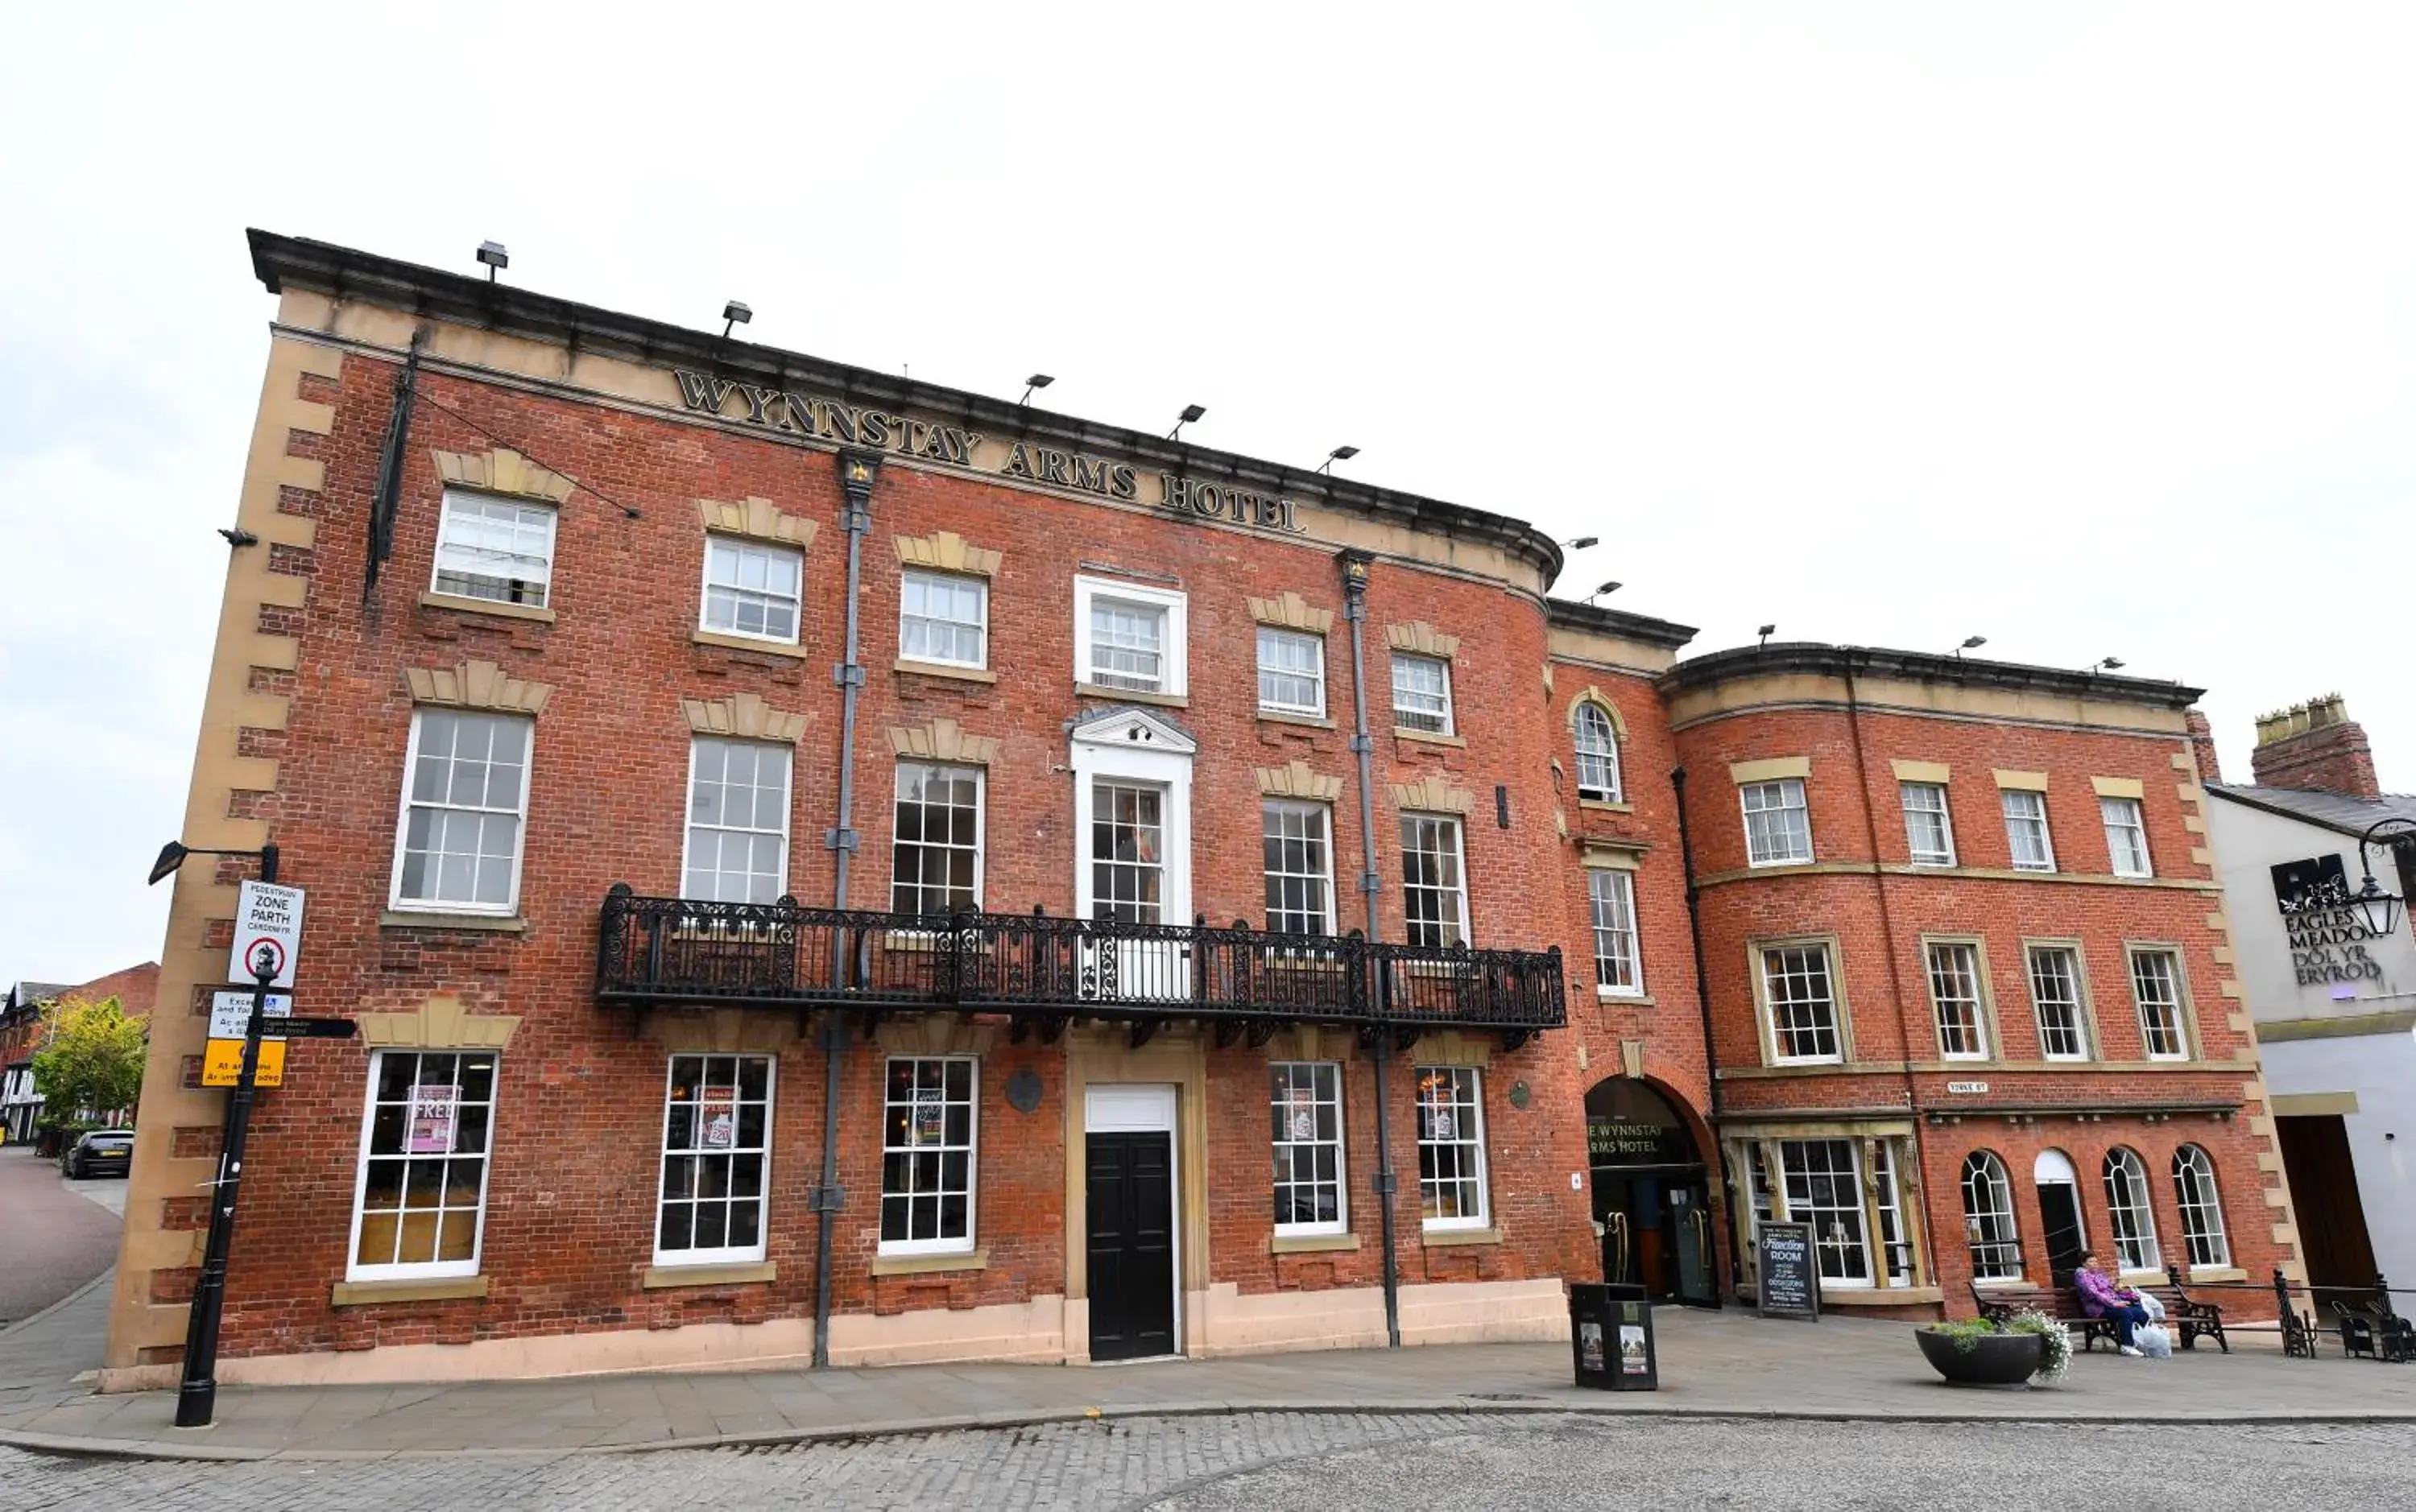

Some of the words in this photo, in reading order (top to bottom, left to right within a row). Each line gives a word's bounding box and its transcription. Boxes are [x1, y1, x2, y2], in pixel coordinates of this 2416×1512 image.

[674, 368, 983, 465] WYNNSTAY
[1002, 442, 1137, 500] ARMS
[1161, 471, 1308, 535] HOTEL
[255, 895, 289, 910] ZONE
[250, 909, 291, 924] PARTH
[2286, 910, 2353, 932] EAGLES
[2290, 925, 2373, 949] MEADO
[2339, 945, 2370, 961] YR
[1599, 1125, 1661, 1137] WYNNSTAY
[1591, 1142, 1616, 1154] RMS
[1619, 1140, 1658, 1153] HOTEL
[1761, 1237, 1805, 1251] Function
[1771, 1250, 1802, 1262] ROOM
